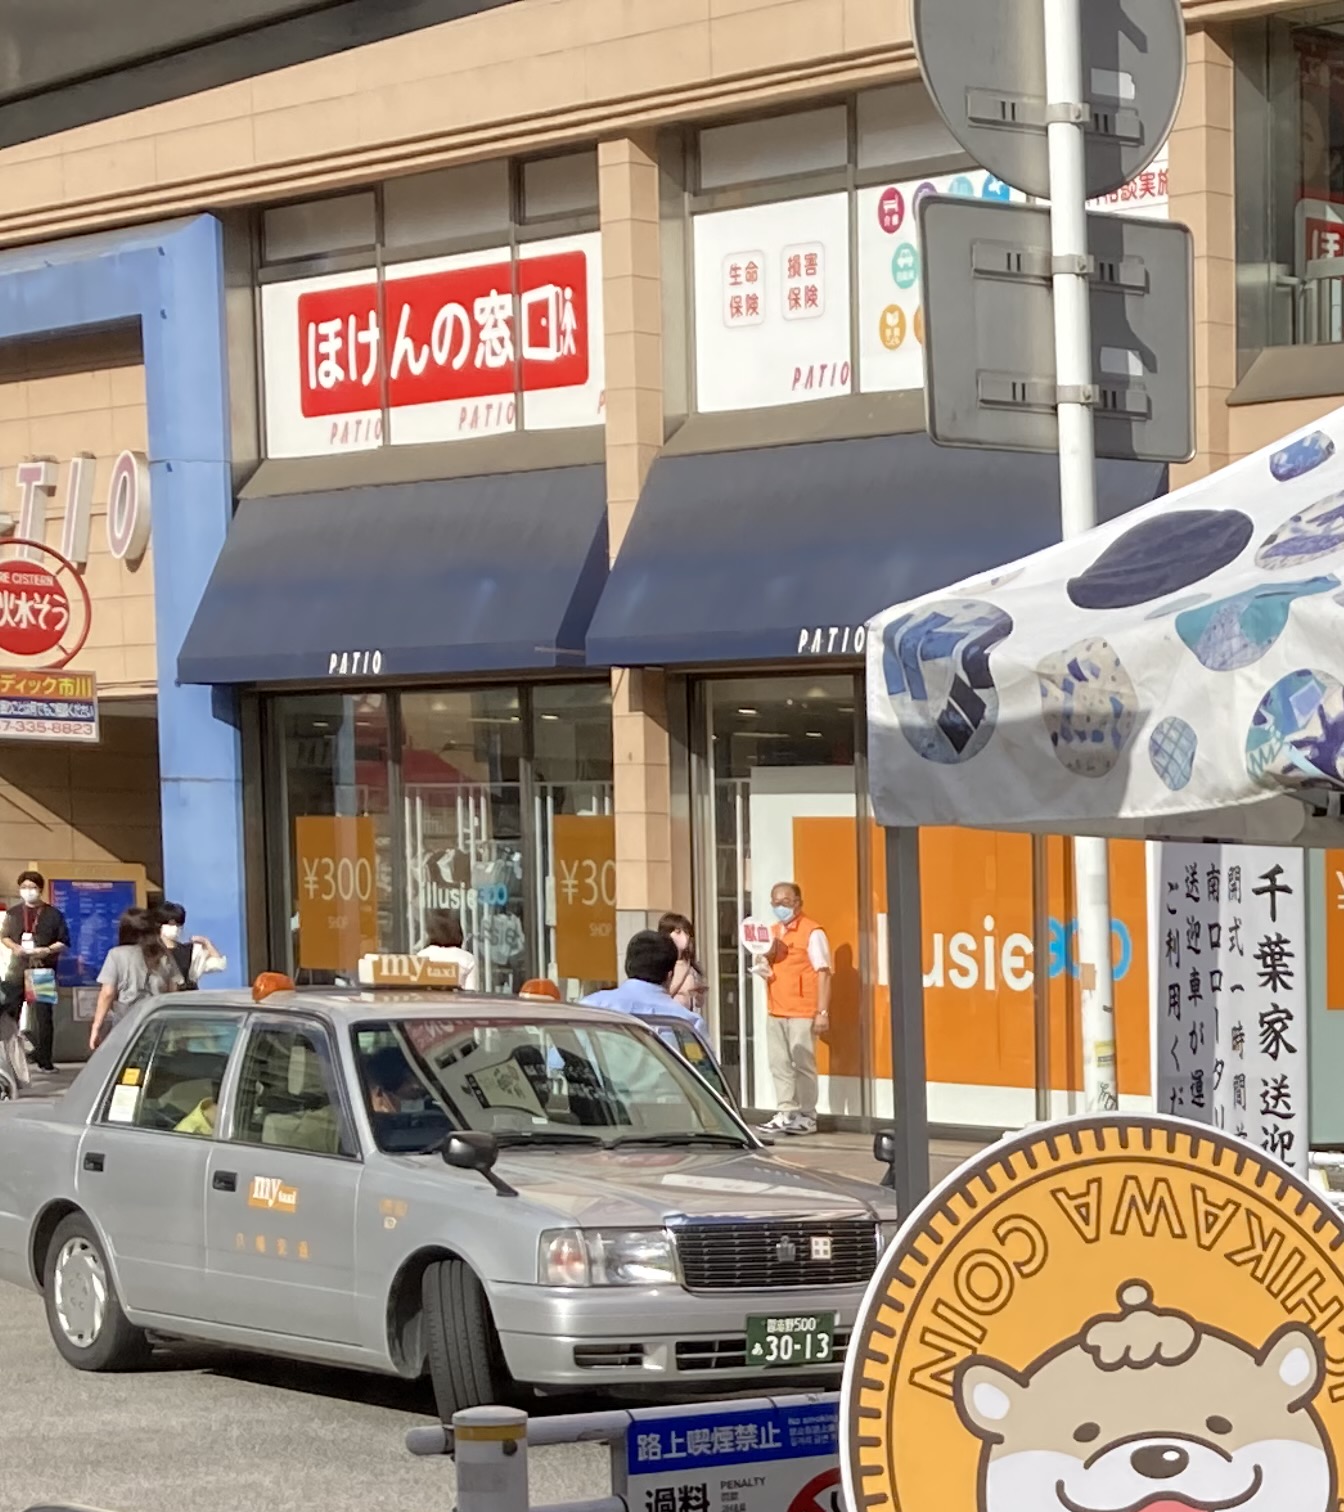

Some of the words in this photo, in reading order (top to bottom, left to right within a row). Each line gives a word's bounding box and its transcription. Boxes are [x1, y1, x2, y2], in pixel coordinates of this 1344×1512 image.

[791, 360, 850, 391] PATIO
[0, 449, 150, 562] TIO
[797, 625, 866, 654] PATIO
[329, 649, 383, 676] PATIO
[303, 857, 372, 901] ¥300
[561, 859, 616, 906] ¥30
[381, 954, 429, 982] my
[427, 964, 456, 979] taxi
[252, 1175, 282, 1208] my
[909, 1213, 1049, 1399] COIN
[765, 1333, 830, 1361] 30-13
[637, 1421, 783, 1462] 路上喫煙禁止
[720, 1476, 767, 1490] PENALTY
